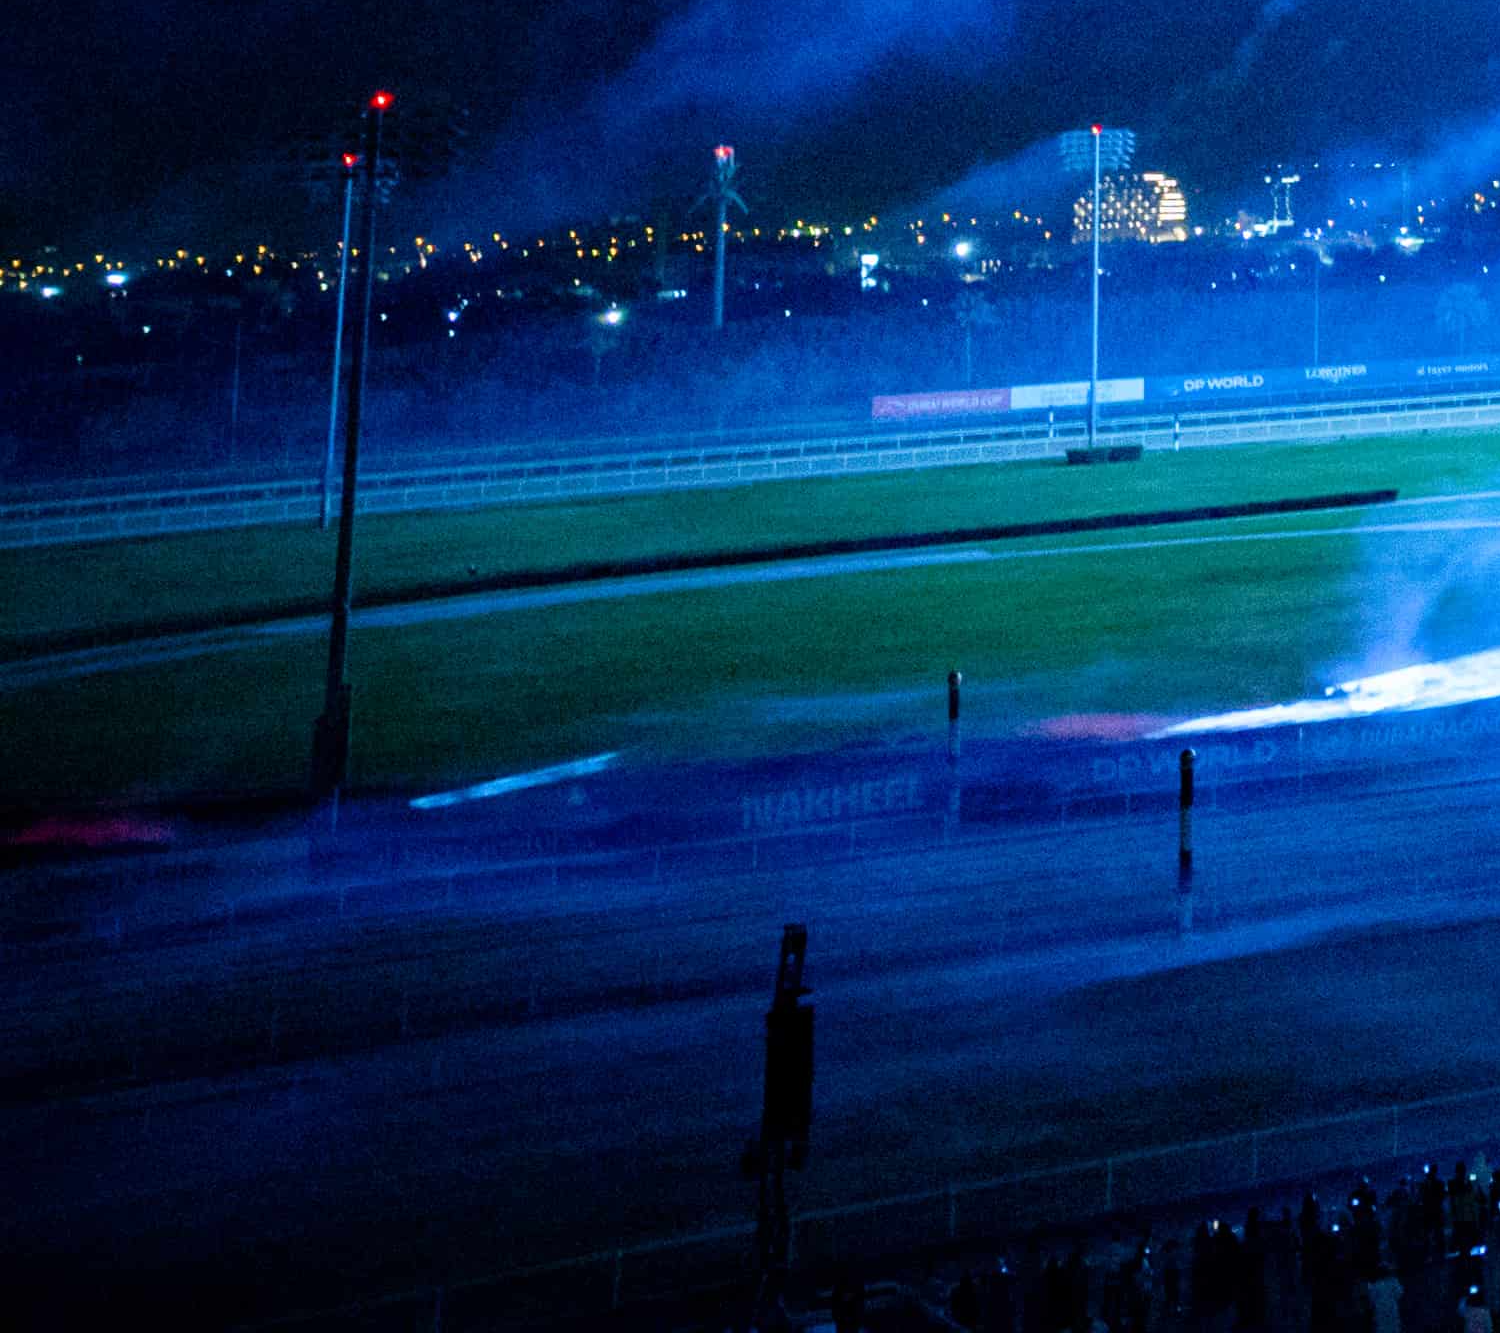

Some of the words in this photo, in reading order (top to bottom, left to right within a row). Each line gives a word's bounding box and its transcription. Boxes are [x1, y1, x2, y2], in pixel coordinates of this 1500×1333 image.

[1184, 377, 1206, 392] DP
[1207, 374, 1264, 390] WORLD
[1091, 754, 1142, 782] DP
[741, 771, 924, 829] NAKHEEL
